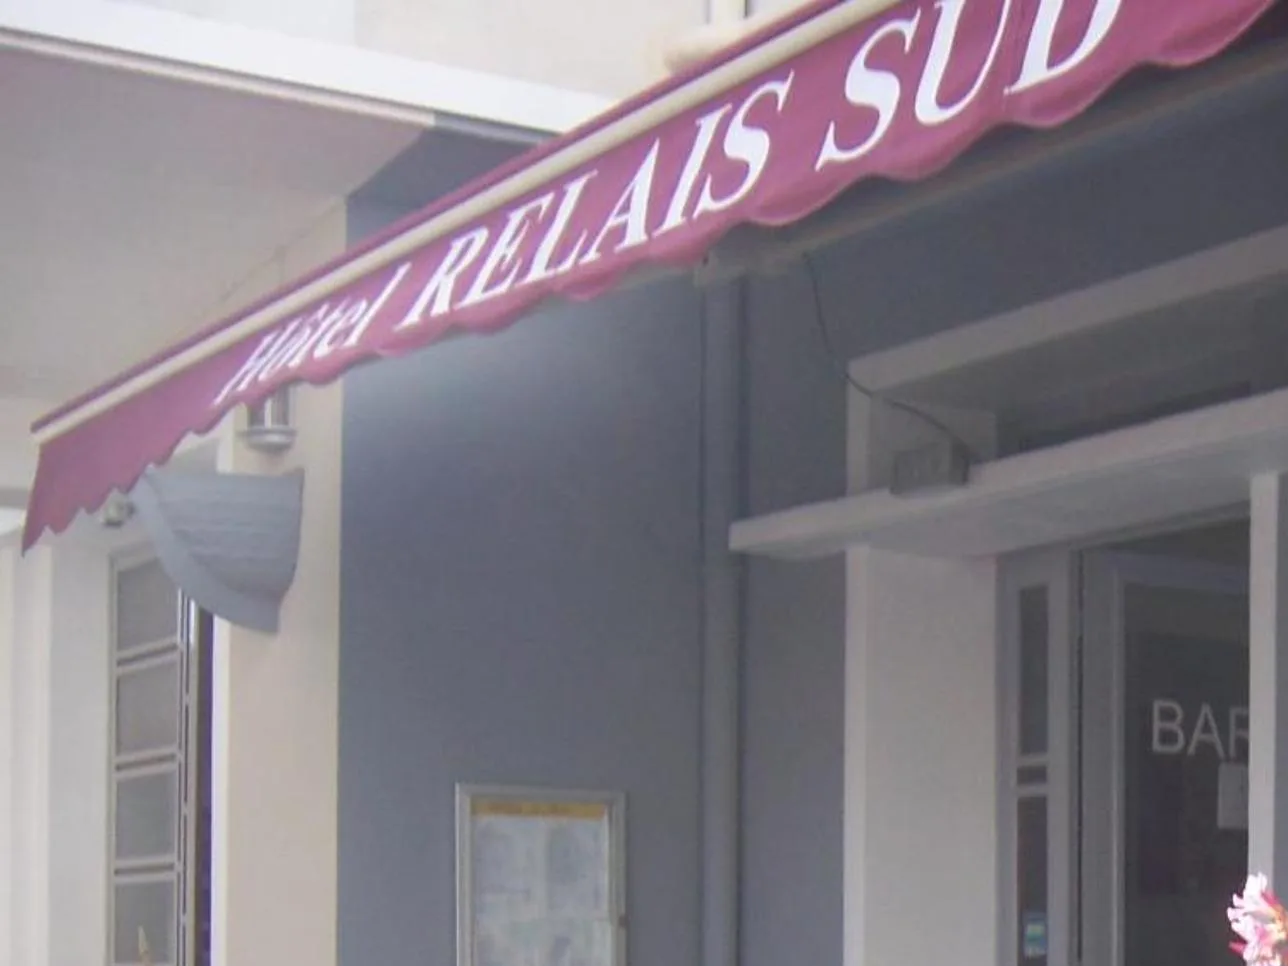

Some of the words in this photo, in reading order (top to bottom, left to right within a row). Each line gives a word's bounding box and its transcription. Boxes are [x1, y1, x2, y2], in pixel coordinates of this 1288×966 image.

[214, 262, 411, 405] Hôtel
[393, 70, 794, 332] RELAIS
[815, 0, 1122, 171] SUD
